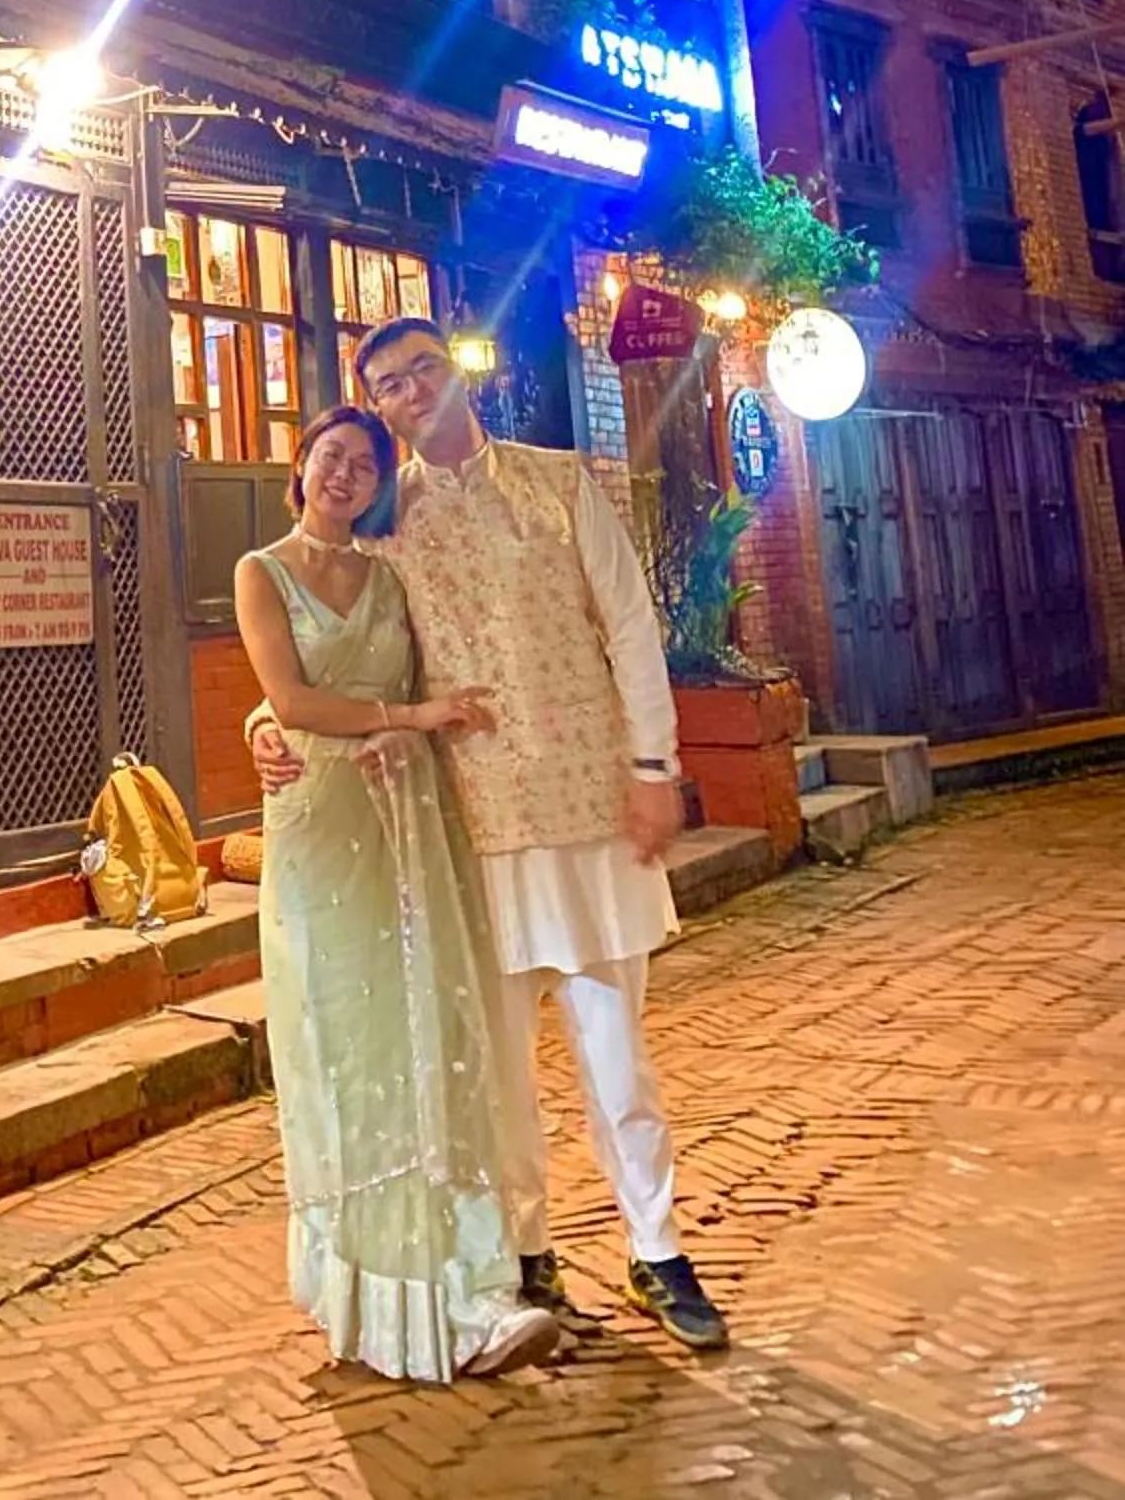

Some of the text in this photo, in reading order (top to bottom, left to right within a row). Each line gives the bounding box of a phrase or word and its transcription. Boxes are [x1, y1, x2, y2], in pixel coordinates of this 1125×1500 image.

[14, 539, 49, 562] GUEST
[52, 539, 87, 562] HOUSE
[23, 568, 46, 584] AND
